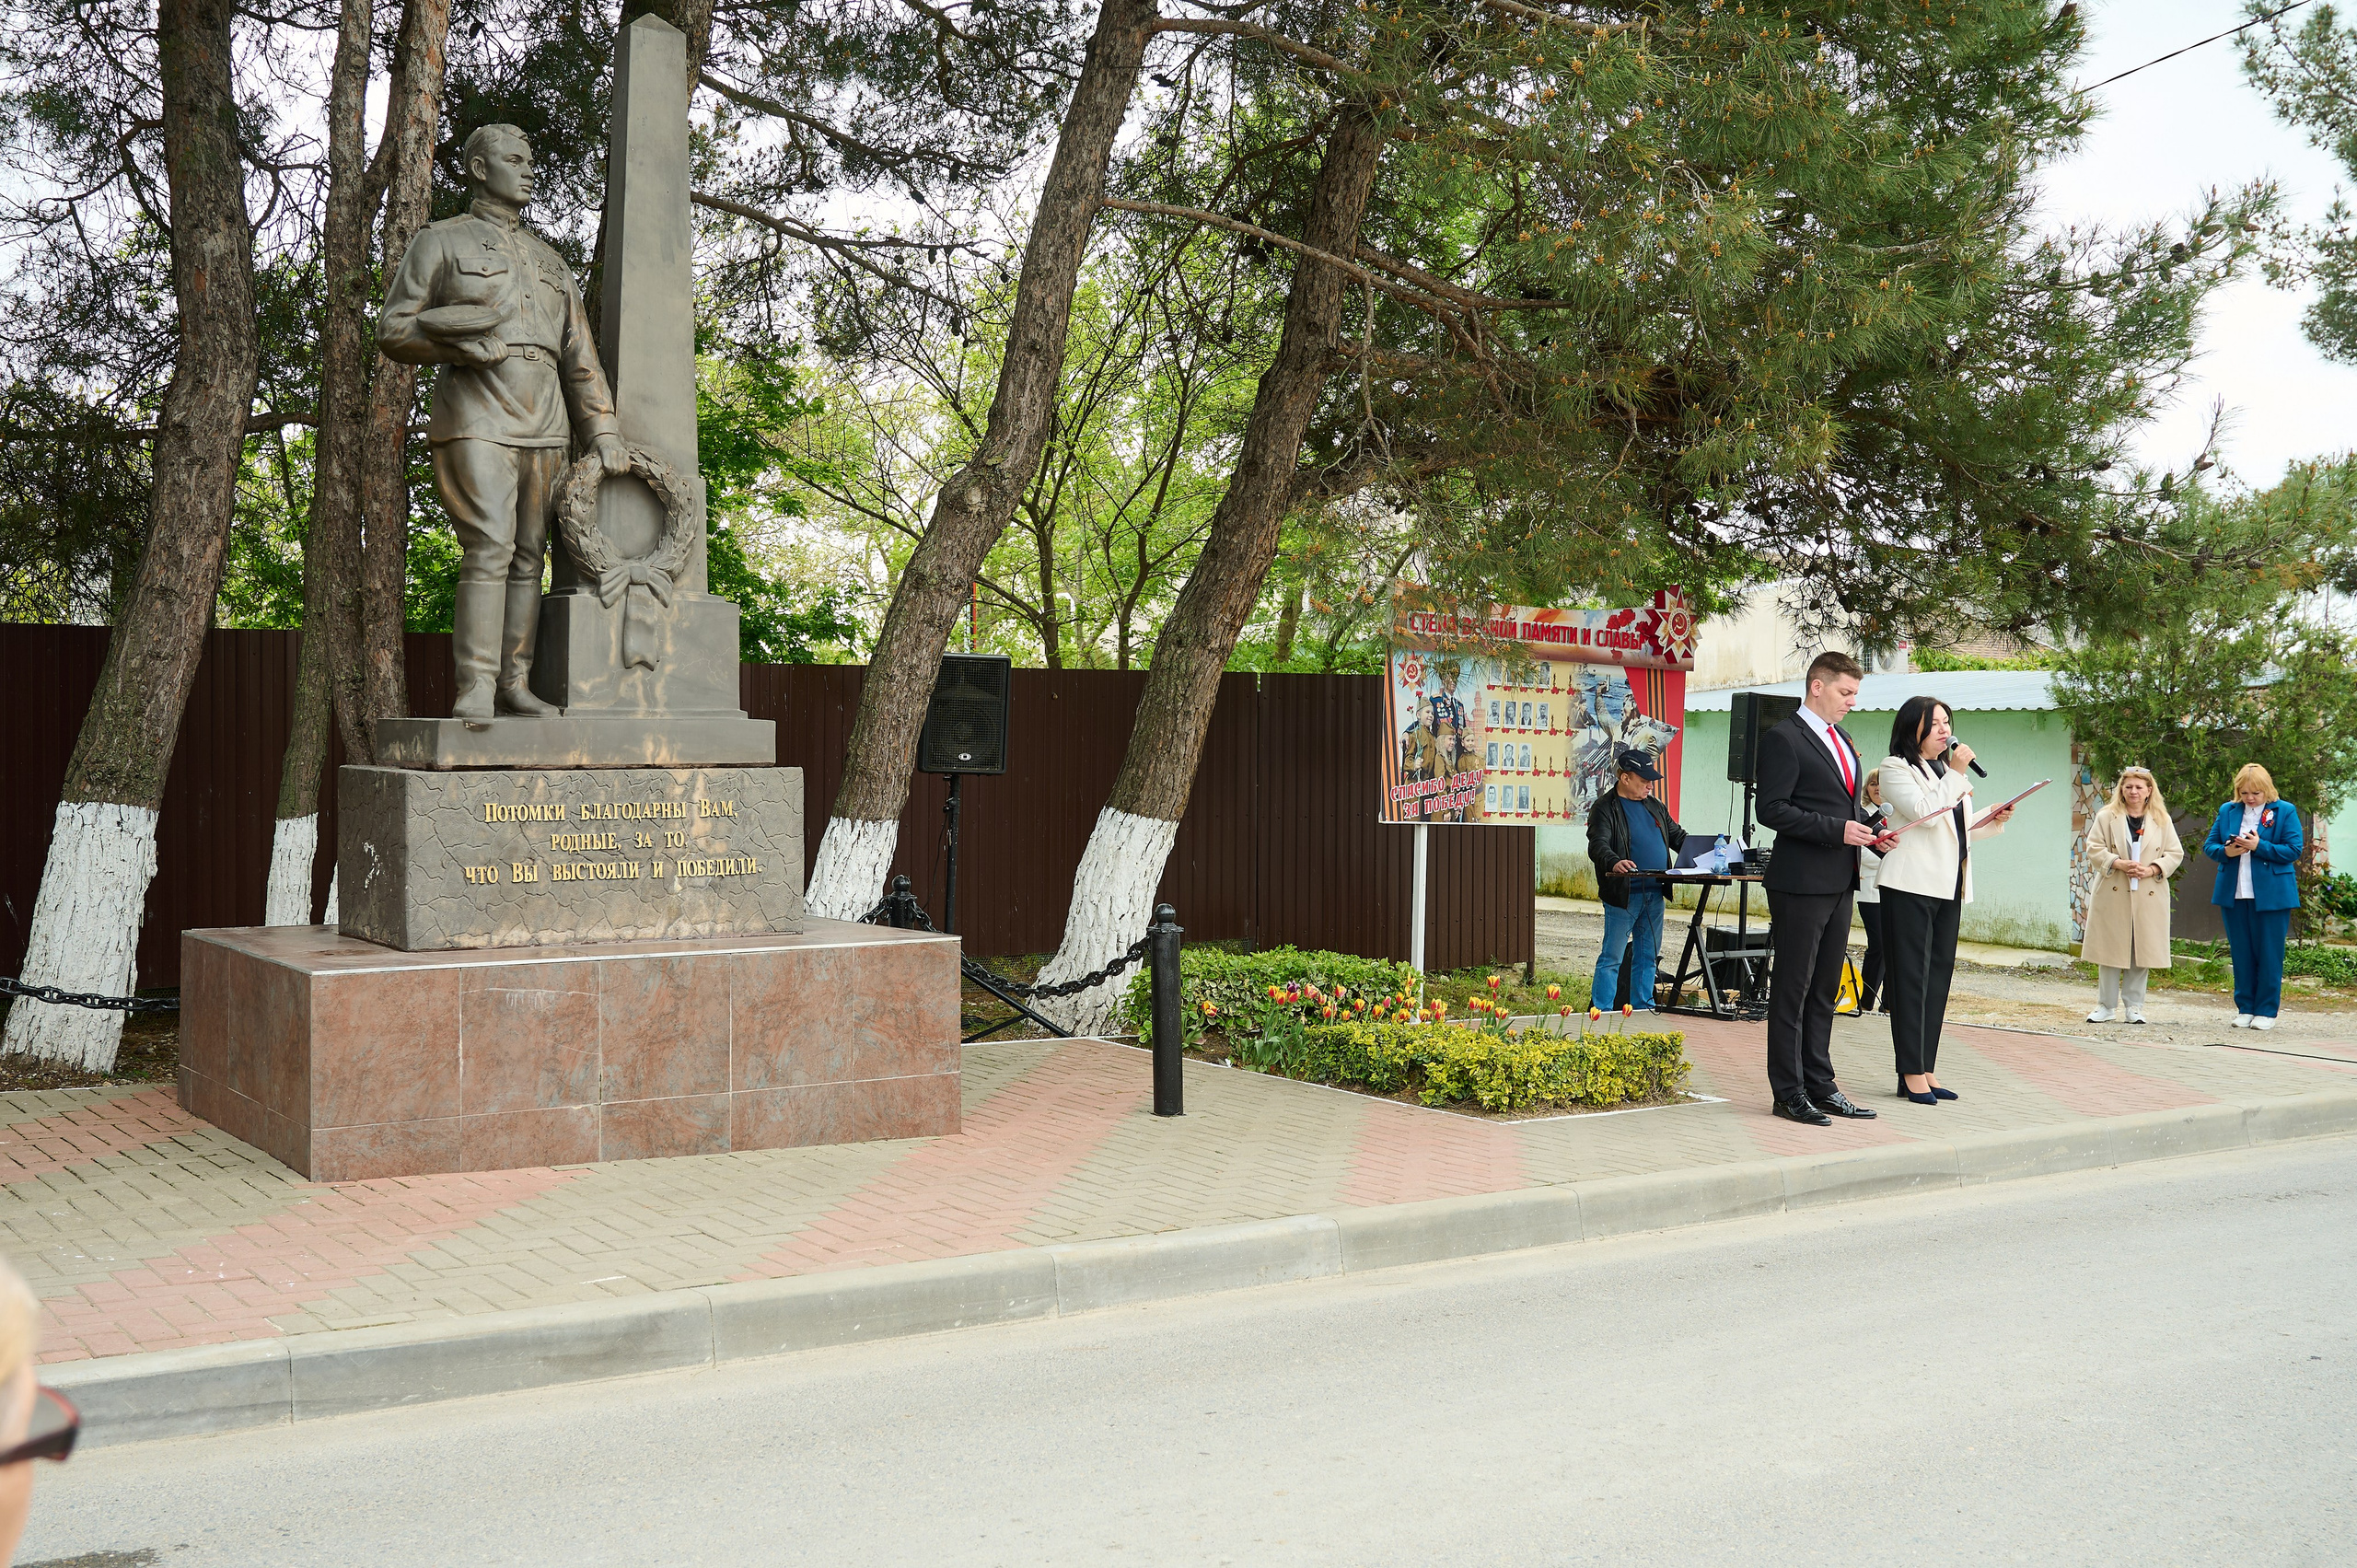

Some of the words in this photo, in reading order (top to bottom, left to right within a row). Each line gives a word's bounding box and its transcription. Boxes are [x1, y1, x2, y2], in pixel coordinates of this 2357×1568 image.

[1523, 622, 1577, 645] ПАМЯТИ
[1583, 628, 1591, 645] И
[1597, 629, 1642, 650] СЛАВЫ
[1390, 776, 1446, 801] СПАСИБО
[1451, 769, 1483, 791] ДЕДУ
[580, 802, 687, 823] БЛАГОДАРНЫ
[1403, 802, 1419, 819] ЗА
[1424, 789, 1475, 814] ПОБЕДУ!
[551, 831, 621, 854] РОДНЫЕ,
[634, 831, 653, 848] ЗА
[465, 865, 498, 884] ЧТО
[552, 862, 640, 881] ВЫСТОЯЛИ
[652, 861, 664, 878] И
